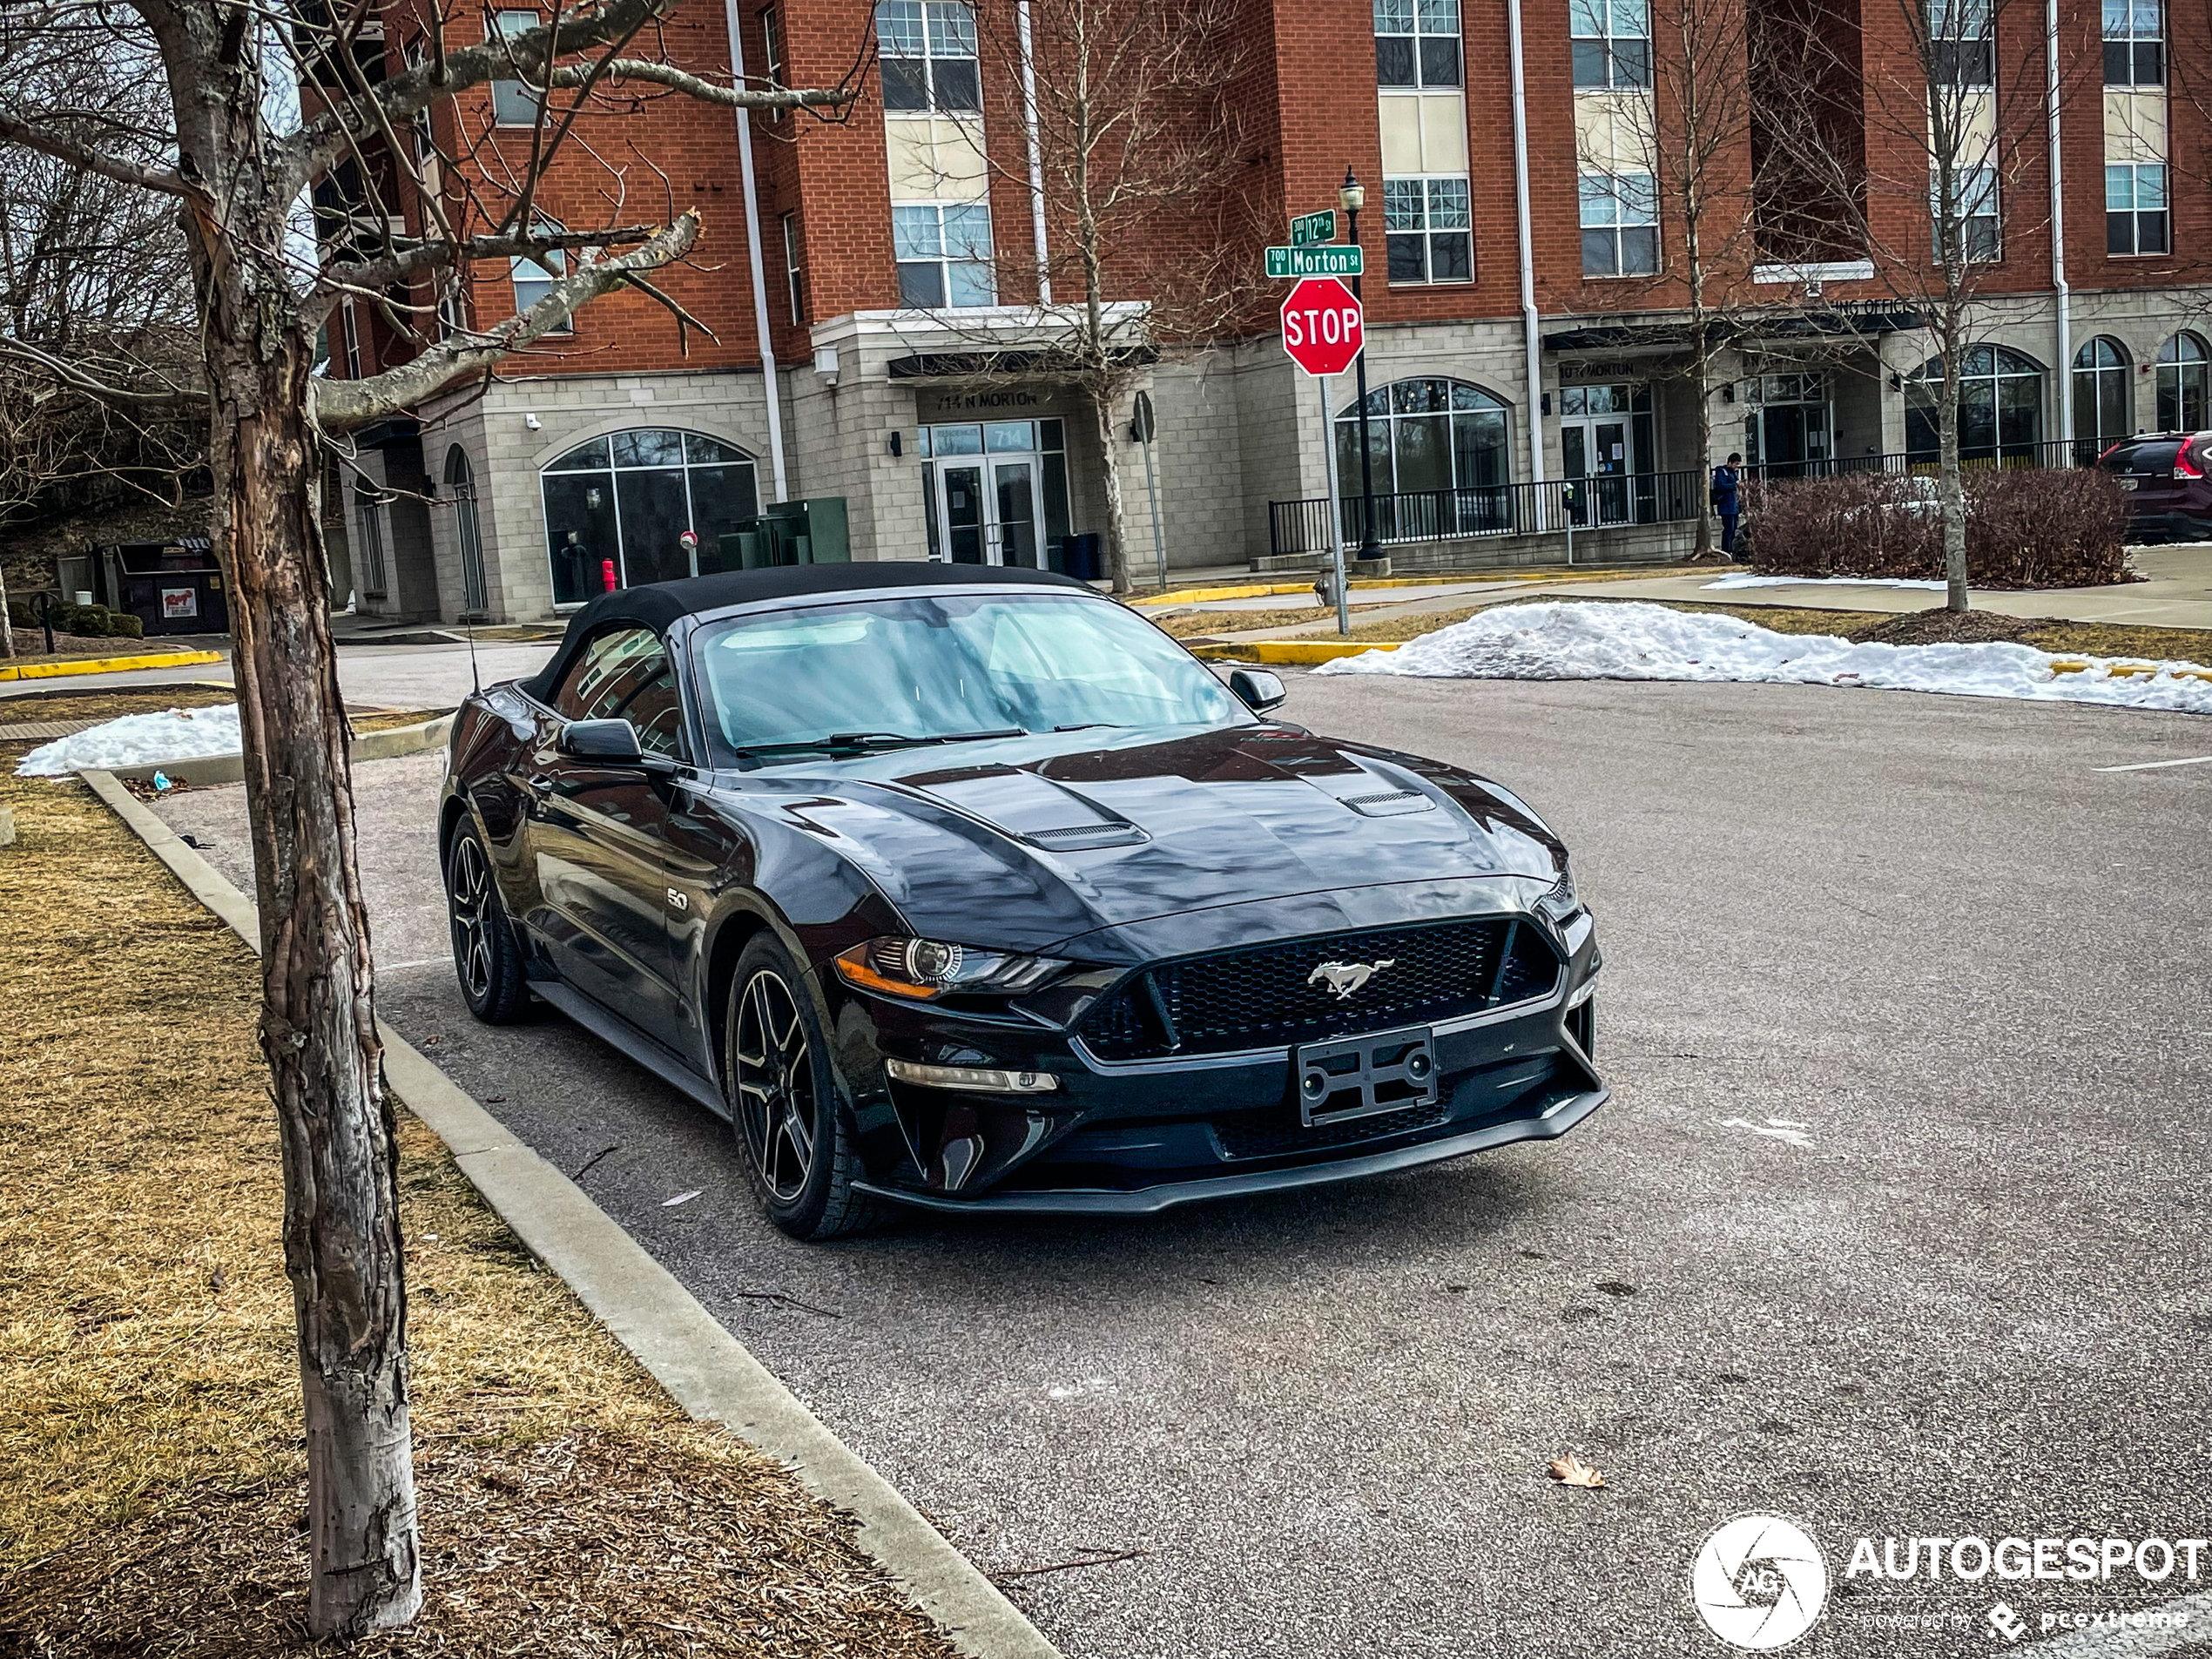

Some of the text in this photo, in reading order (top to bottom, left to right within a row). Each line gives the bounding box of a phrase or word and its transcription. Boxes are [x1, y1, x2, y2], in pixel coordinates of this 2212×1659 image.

[1270, 250, 1285, 261] 700
[1293, 250, 1359, 273] Morton St
[1275, 263, 1282, 273] N
[1285, 307, 1359, 347] STOP
[1587, 362, 1634, 377] MORTON
[966, 395, 975, 408] N
[980, 391, 1037, 408] MORTON
[995, 429, 1022, 447] 714
